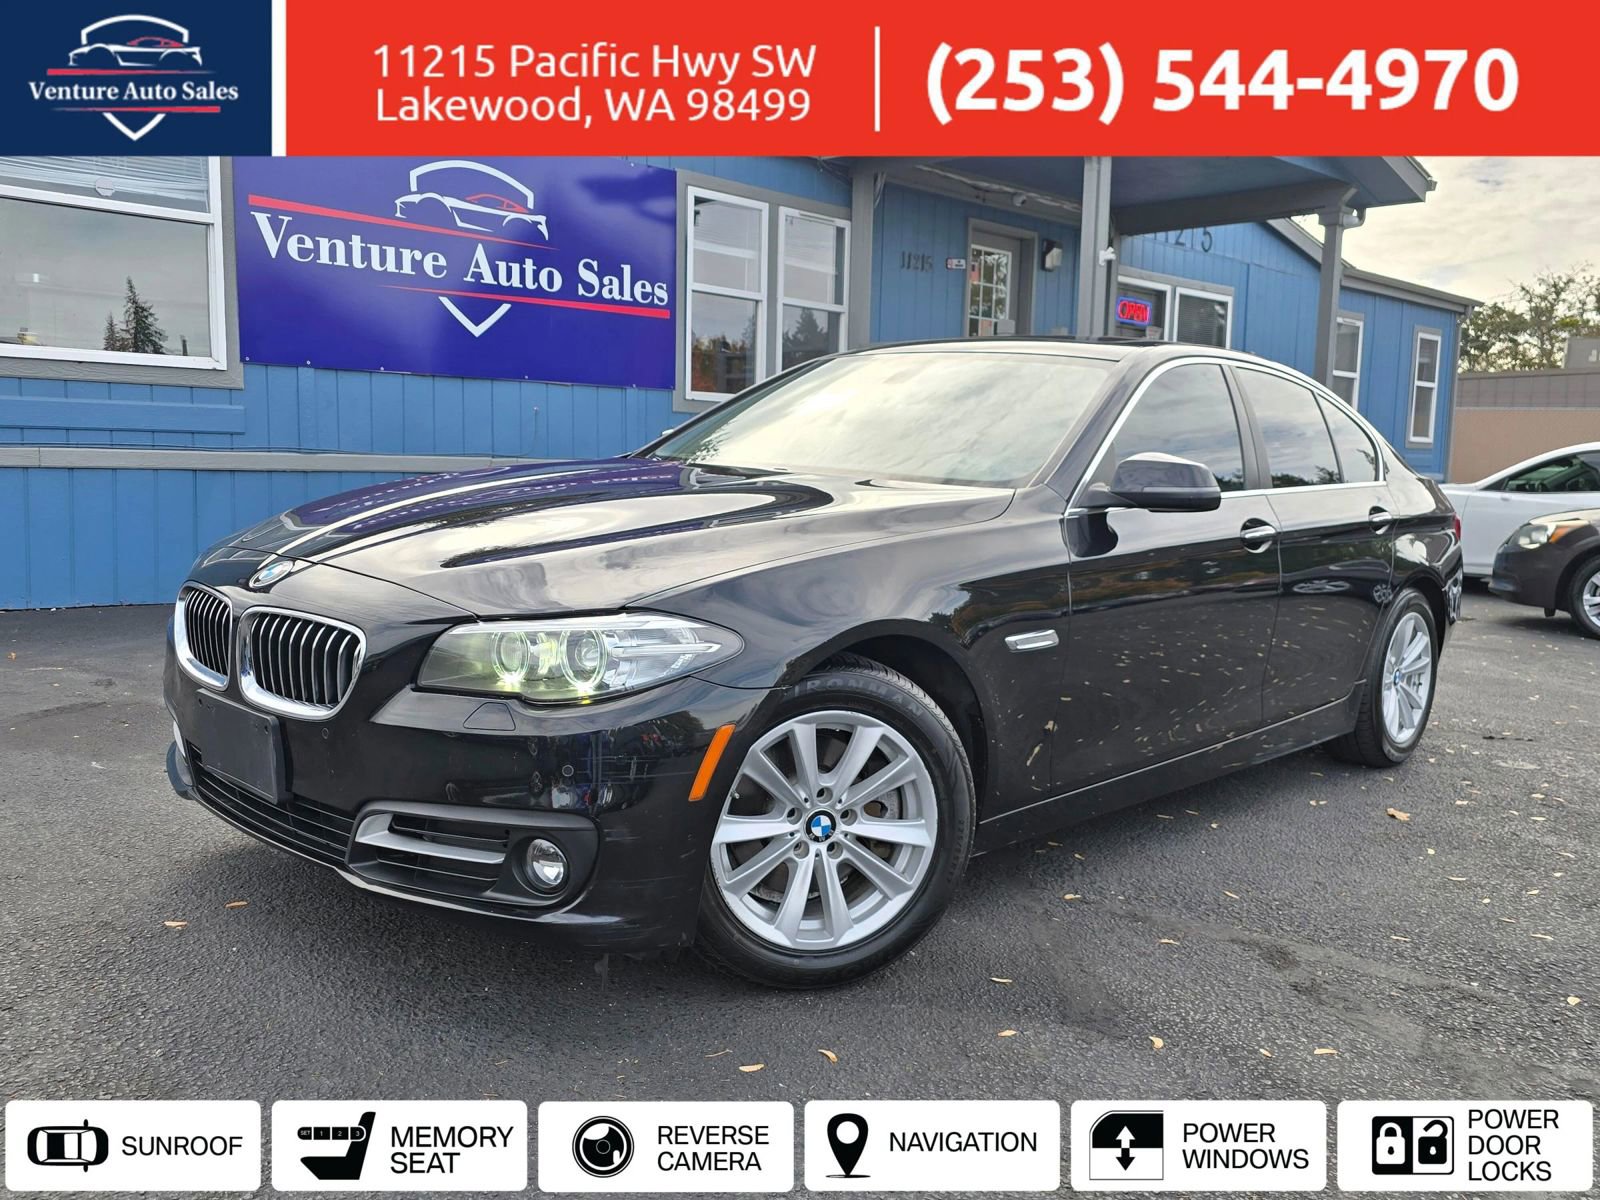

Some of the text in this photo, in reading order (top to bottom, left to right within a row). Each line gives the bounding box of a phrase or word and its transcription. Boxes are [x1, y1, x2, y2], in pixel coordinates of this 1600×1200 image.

[250, 211, 669, 306] Venture Auto Sales
[1118, 300, 1150, 323] OPEN
